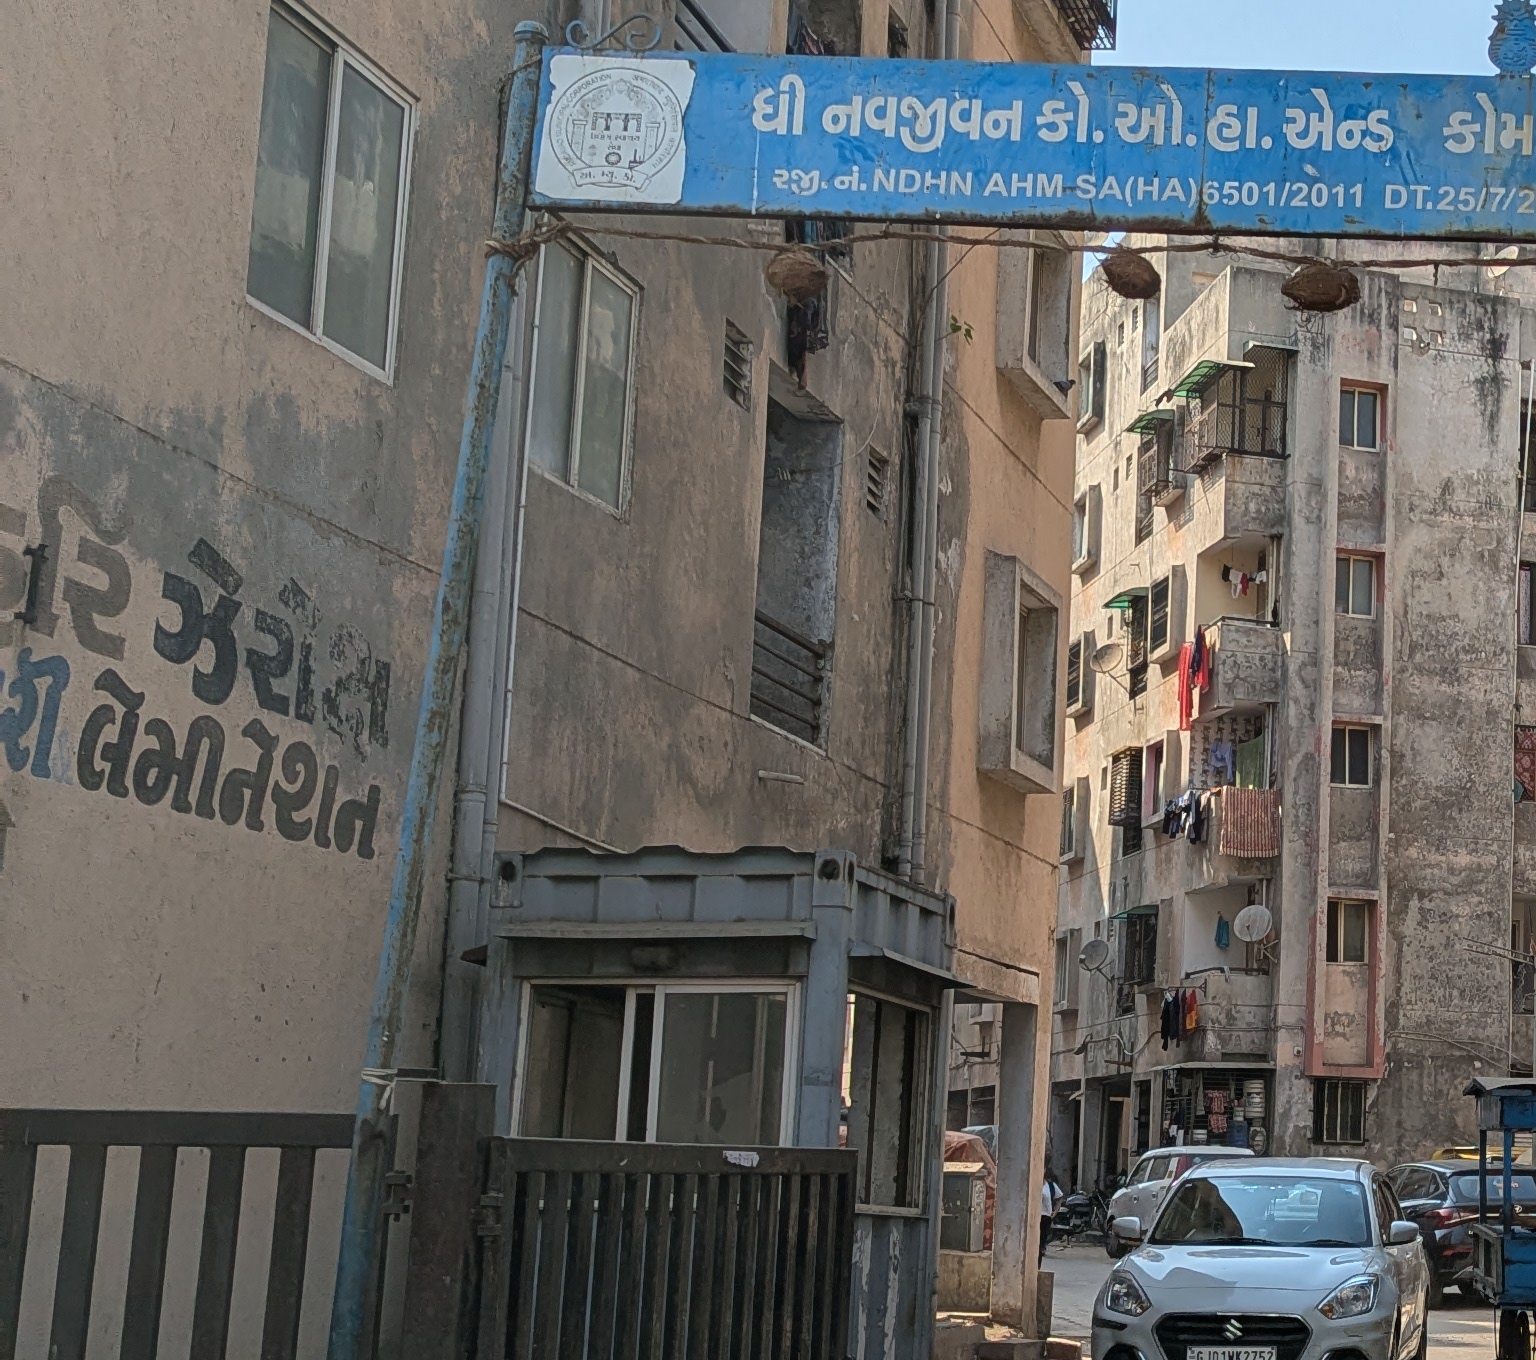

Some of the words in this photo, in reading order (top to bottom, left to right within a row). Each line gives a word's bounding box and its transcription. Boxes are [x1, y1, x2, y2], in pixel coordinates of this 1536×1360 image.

[752, 74, 805, 135] ધી
[822, 96, 1022, 153] નવજીવન
[1283, 89, 1395, 153] એન્ડ
[873, 169, 971, 195] NDHN
[983, 173, 1062, 198] AHM
[76, 668, 381, 861] લેમીનેશન
